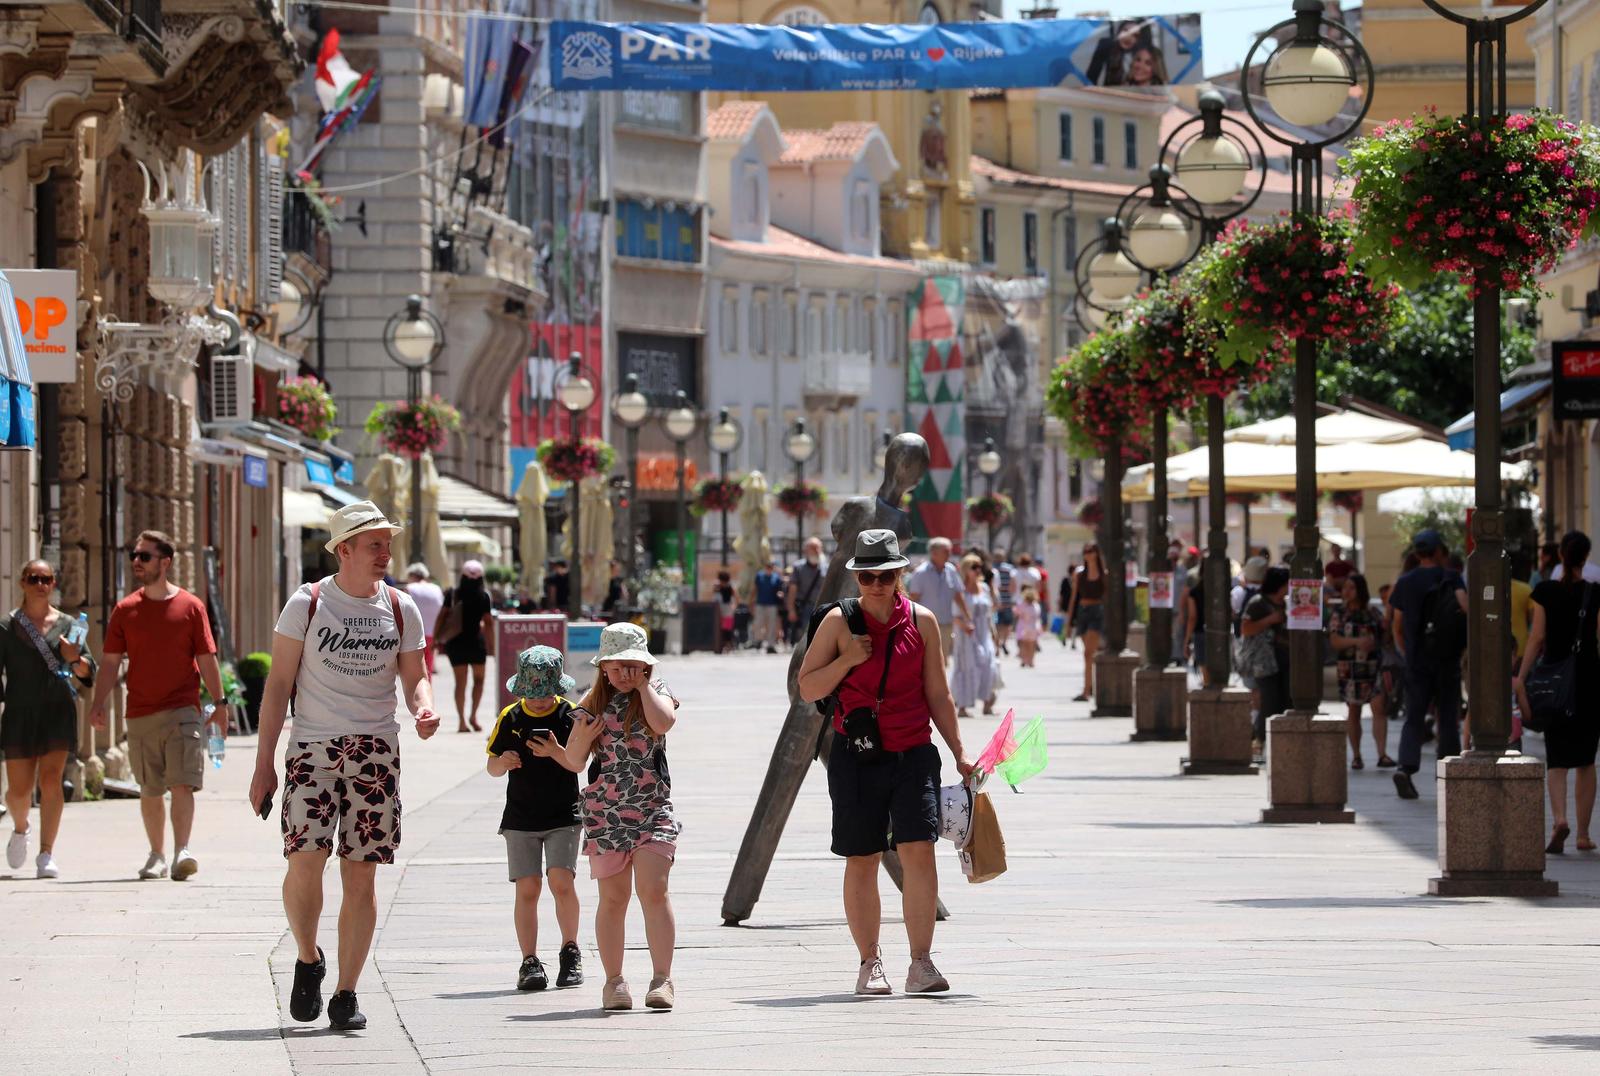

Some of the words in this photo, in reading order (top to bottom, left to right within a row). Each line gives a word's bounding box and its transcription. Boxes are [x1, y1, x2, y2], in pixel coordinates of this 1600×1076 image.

[620, 32, 712, 61] PAR
[872, 48, 905, 61] PAR
[910, 50, 921, 61] u
[841, 78, 917, 91] www.par.hr
[343, 617, 381, 627] GREATEST
[504, 622, 559, 634] SCARLET
[318, 627, 399, 652] Warrior
[352, 653, 377, 661] ANGELES
[322, 658, 354, 676] REGISTERED
[355, 664, 386, 677] TRADEMARK
